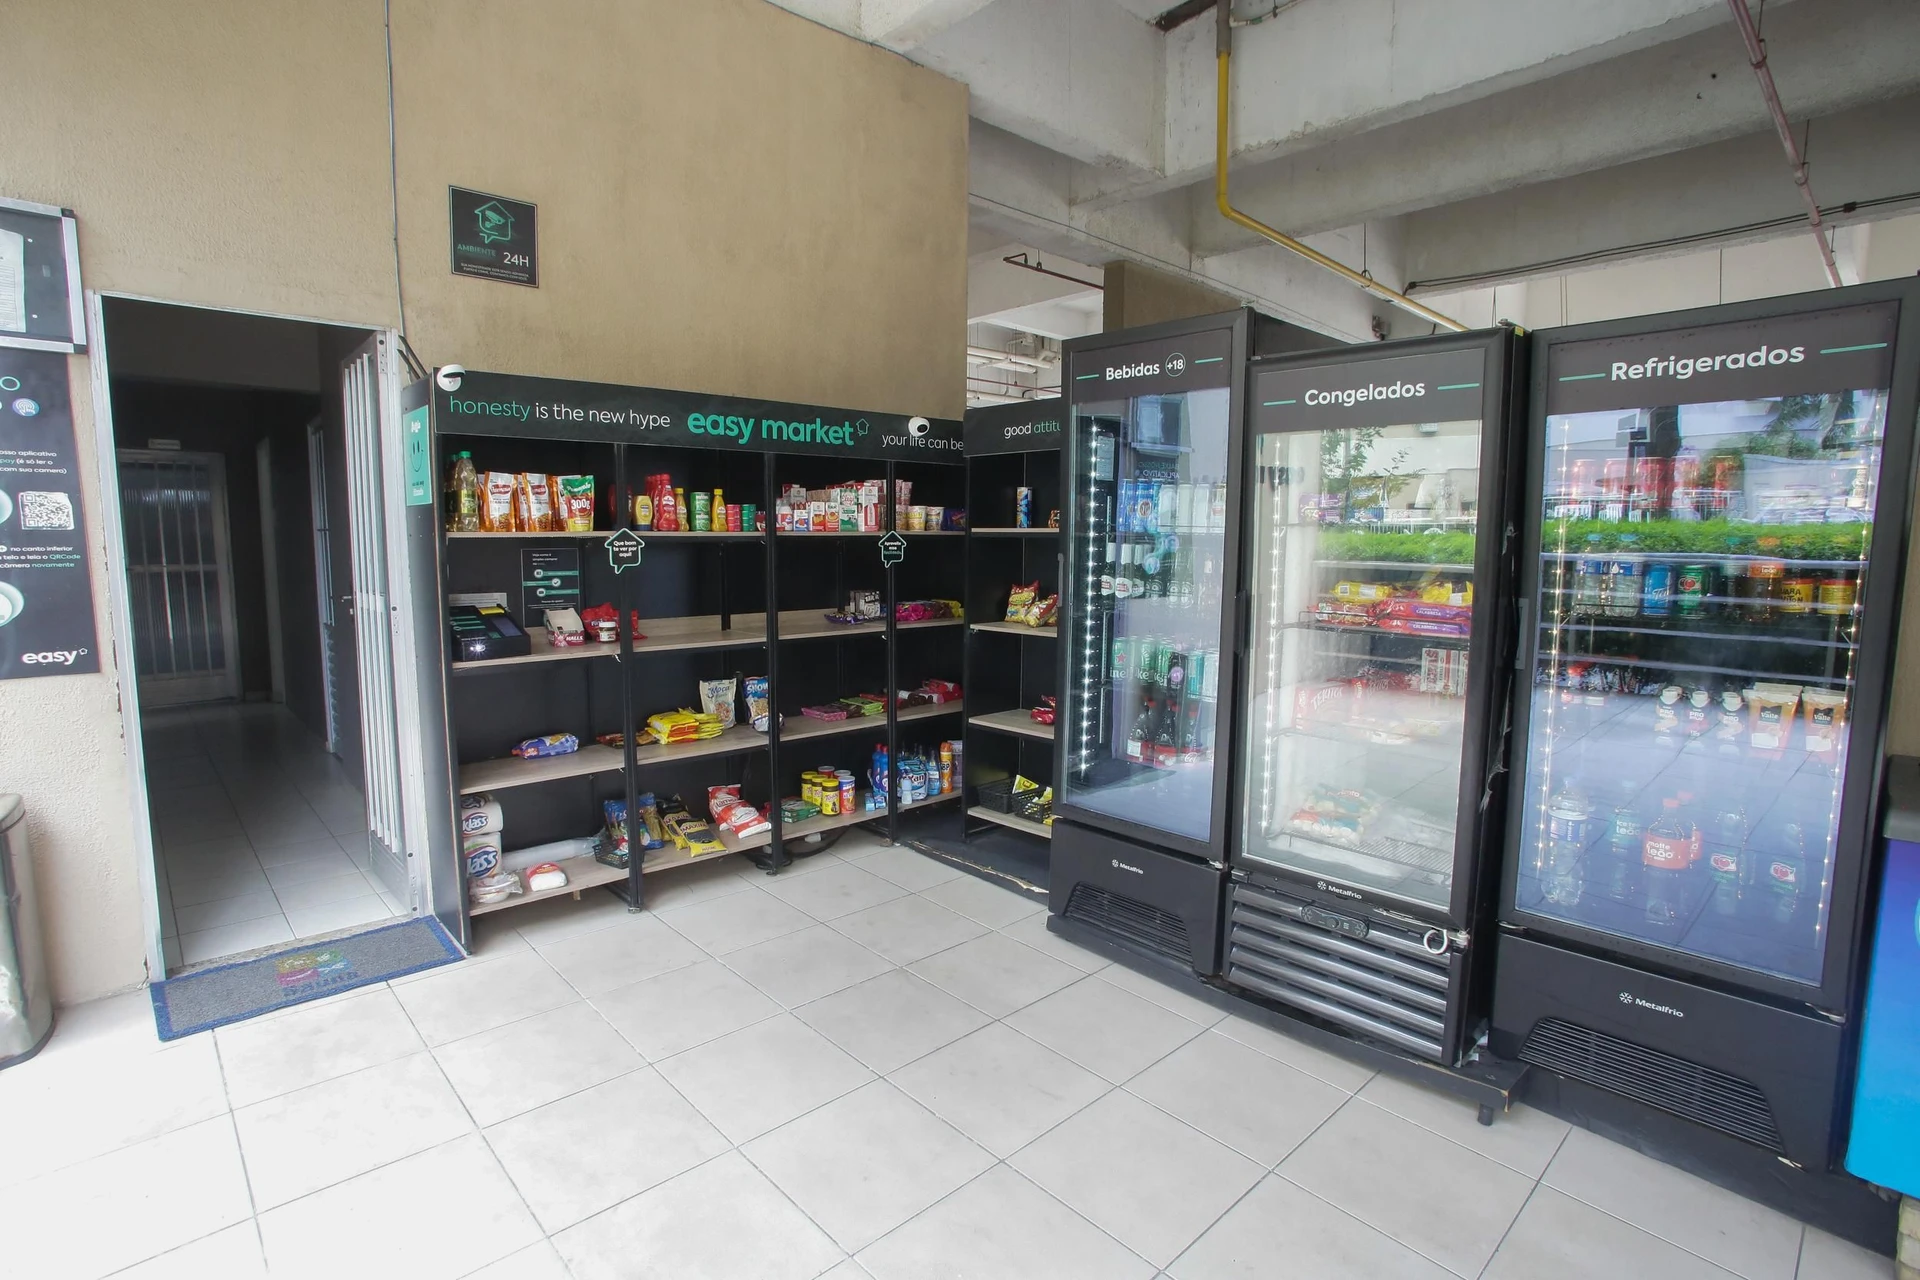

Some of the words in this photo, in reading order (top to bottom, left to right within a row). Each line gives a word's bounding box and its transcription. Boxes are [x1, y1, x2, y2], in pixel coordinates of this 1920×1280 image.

[457, 244, 497, 257] AMBIENTE
[503, 252, 529, 267] 24H
[1106, 362, 1160, 380] Bebidas
[1166, 359, 1184, 370] +18
[1611, 345, 1805, 381] Refrigerados
[1305, 381, 1425, 406] Congelados
[450, 396, 531, 421] honesty
[535, 403, 549, 419] is
[553, 403, 584, 421] the
[589, 409, 625, 424] new
[629, 409, 671, 430] hype
[687, 412, 754, 445] easy
[761, 418, 854, 446] market
[1004, 422, 1032, 439] good
[882, 433, 907, 447] your
[927, 438, 948, 450] can
[950, 437, 963, 450] be
[571, 499, 590, 510] 300g
[22, 650, 78, 665] easy
[1761, 712, 1779, 720] Valle
[1647, 847, 1674, 859] leão
[1649, 841, 1671, 850] matte
[1119, 862, 1144, 874] Metalfrio
[1328, 885, 1362, 900] Metalfrio
[1635, 998, 1684, 1017] Metalfrio
